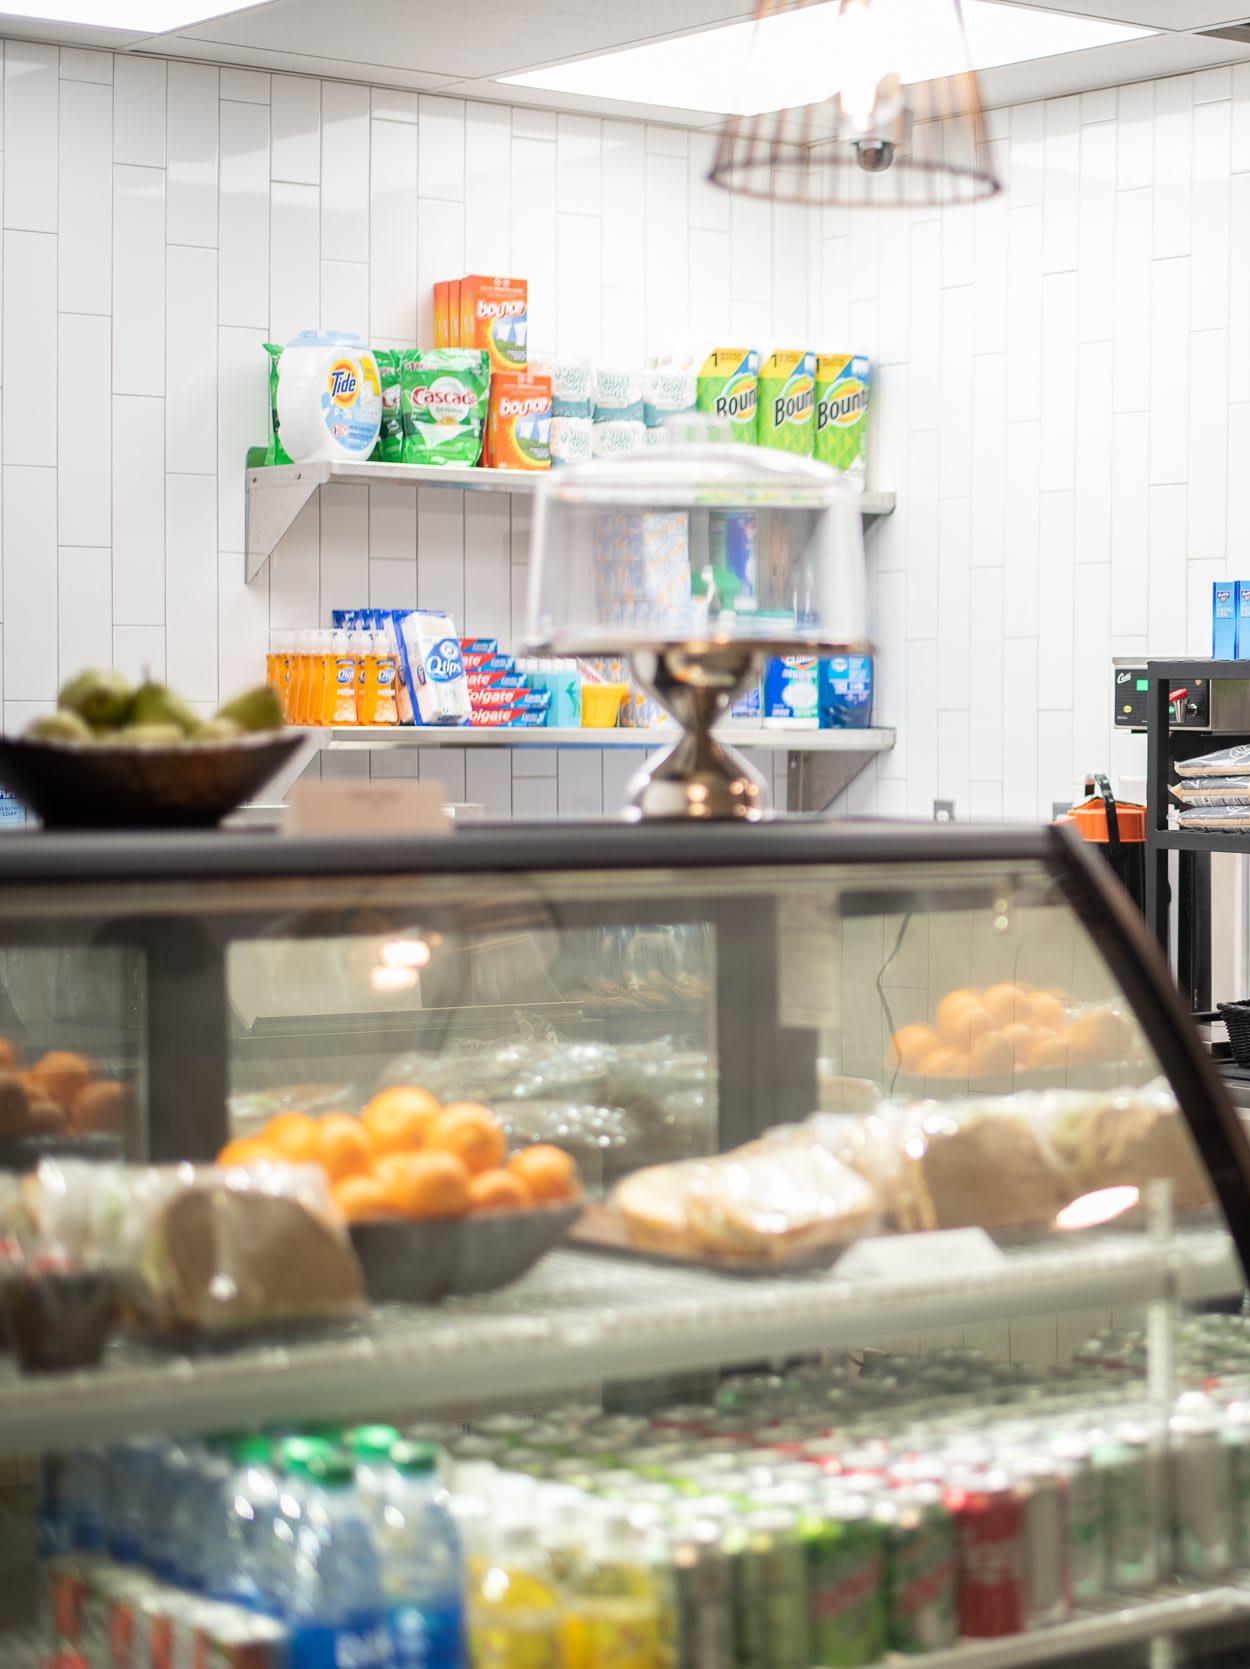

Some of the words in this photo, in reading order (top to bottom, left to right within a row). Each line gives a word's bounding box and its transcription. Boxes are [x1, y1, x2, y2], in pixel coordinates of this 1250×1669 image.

[477, 299, 525, 319] bounce
[331, 371, 356, 397] Tide
[500, 398, 549, 417] bounce
[470, 708, 512, 724] olgate
